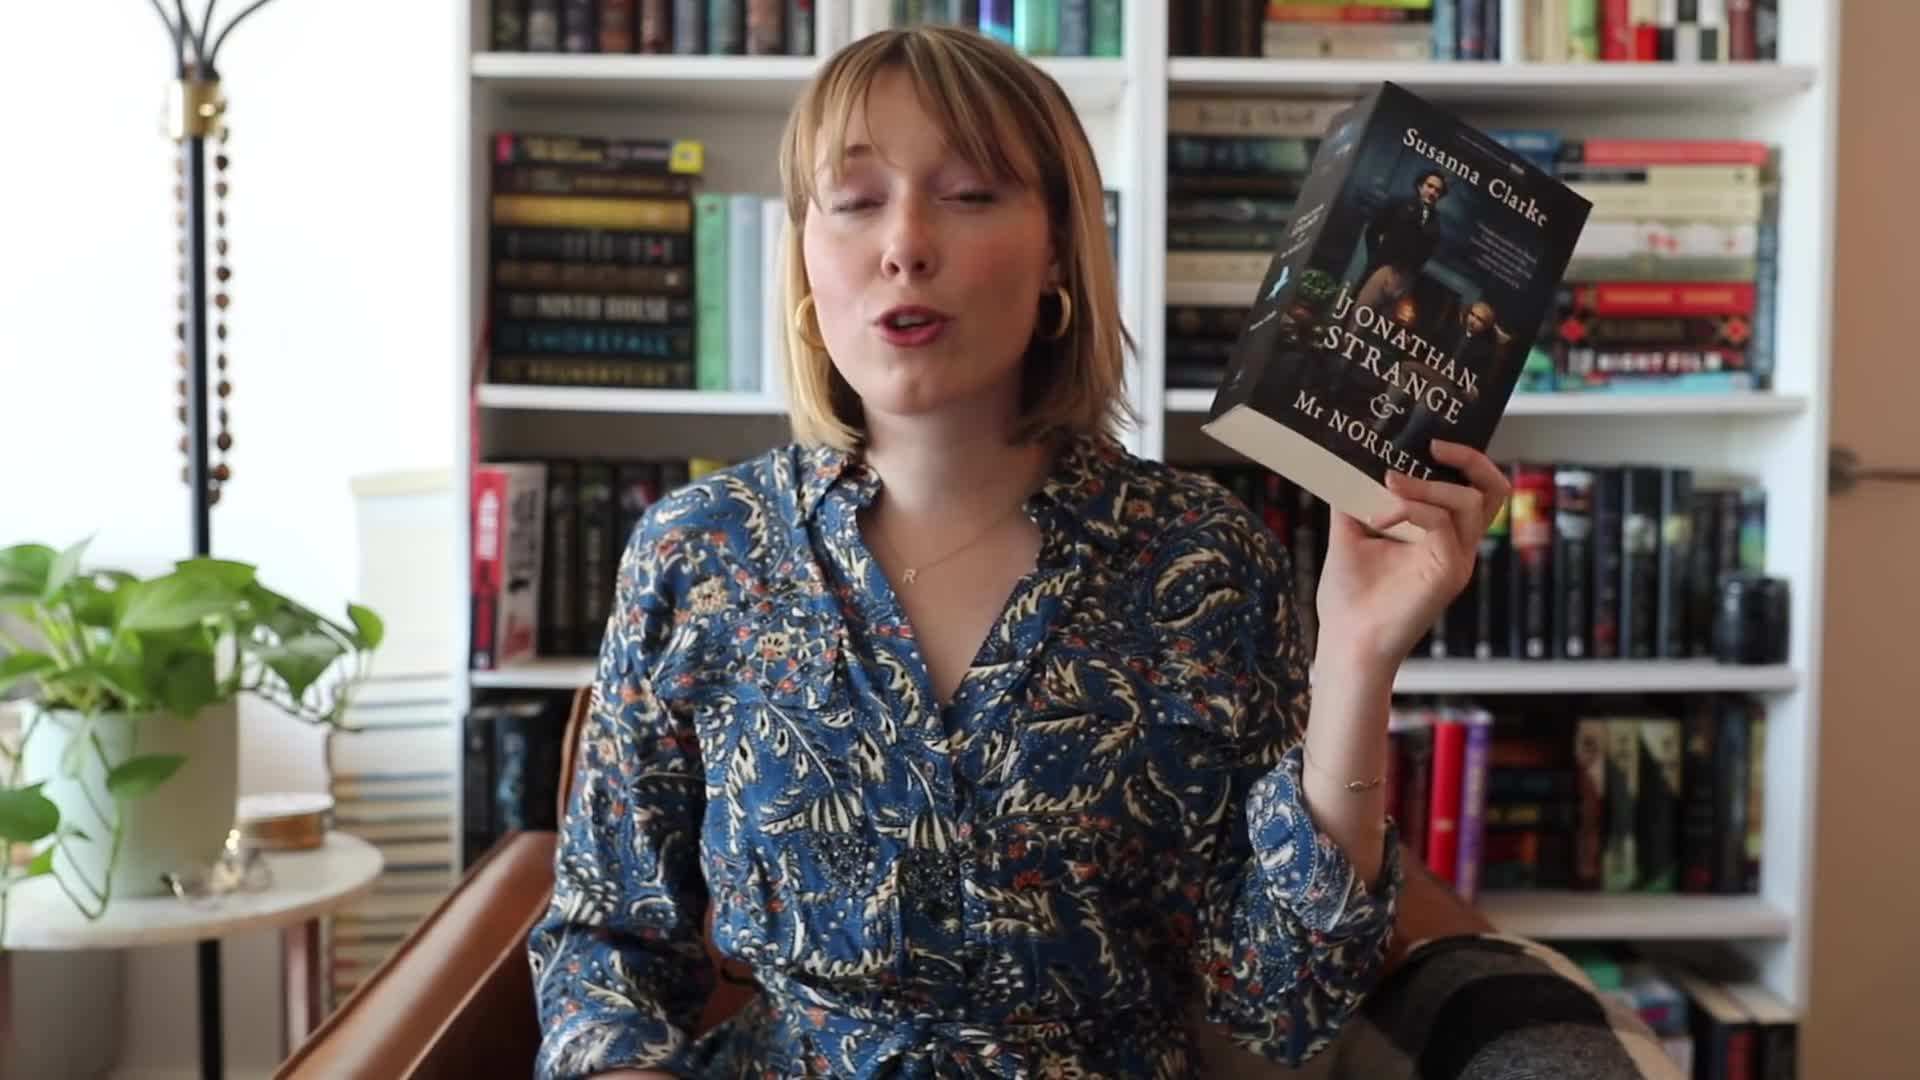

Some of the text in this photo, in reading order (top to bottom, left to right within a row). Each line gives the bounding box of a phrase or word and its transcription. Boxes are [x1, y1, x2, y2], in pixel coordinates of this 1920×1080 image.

[1402, 128, 1480, 185] Susanna
[1488, 178, 1548, 227] Clarke
[1324, 326, 1463, 425] STRANGE
[1331, 283, 1478, 392] JONATHAN
[1293, 390, 1324, 419] Mr
[1370, 393, 1404, 419] &
